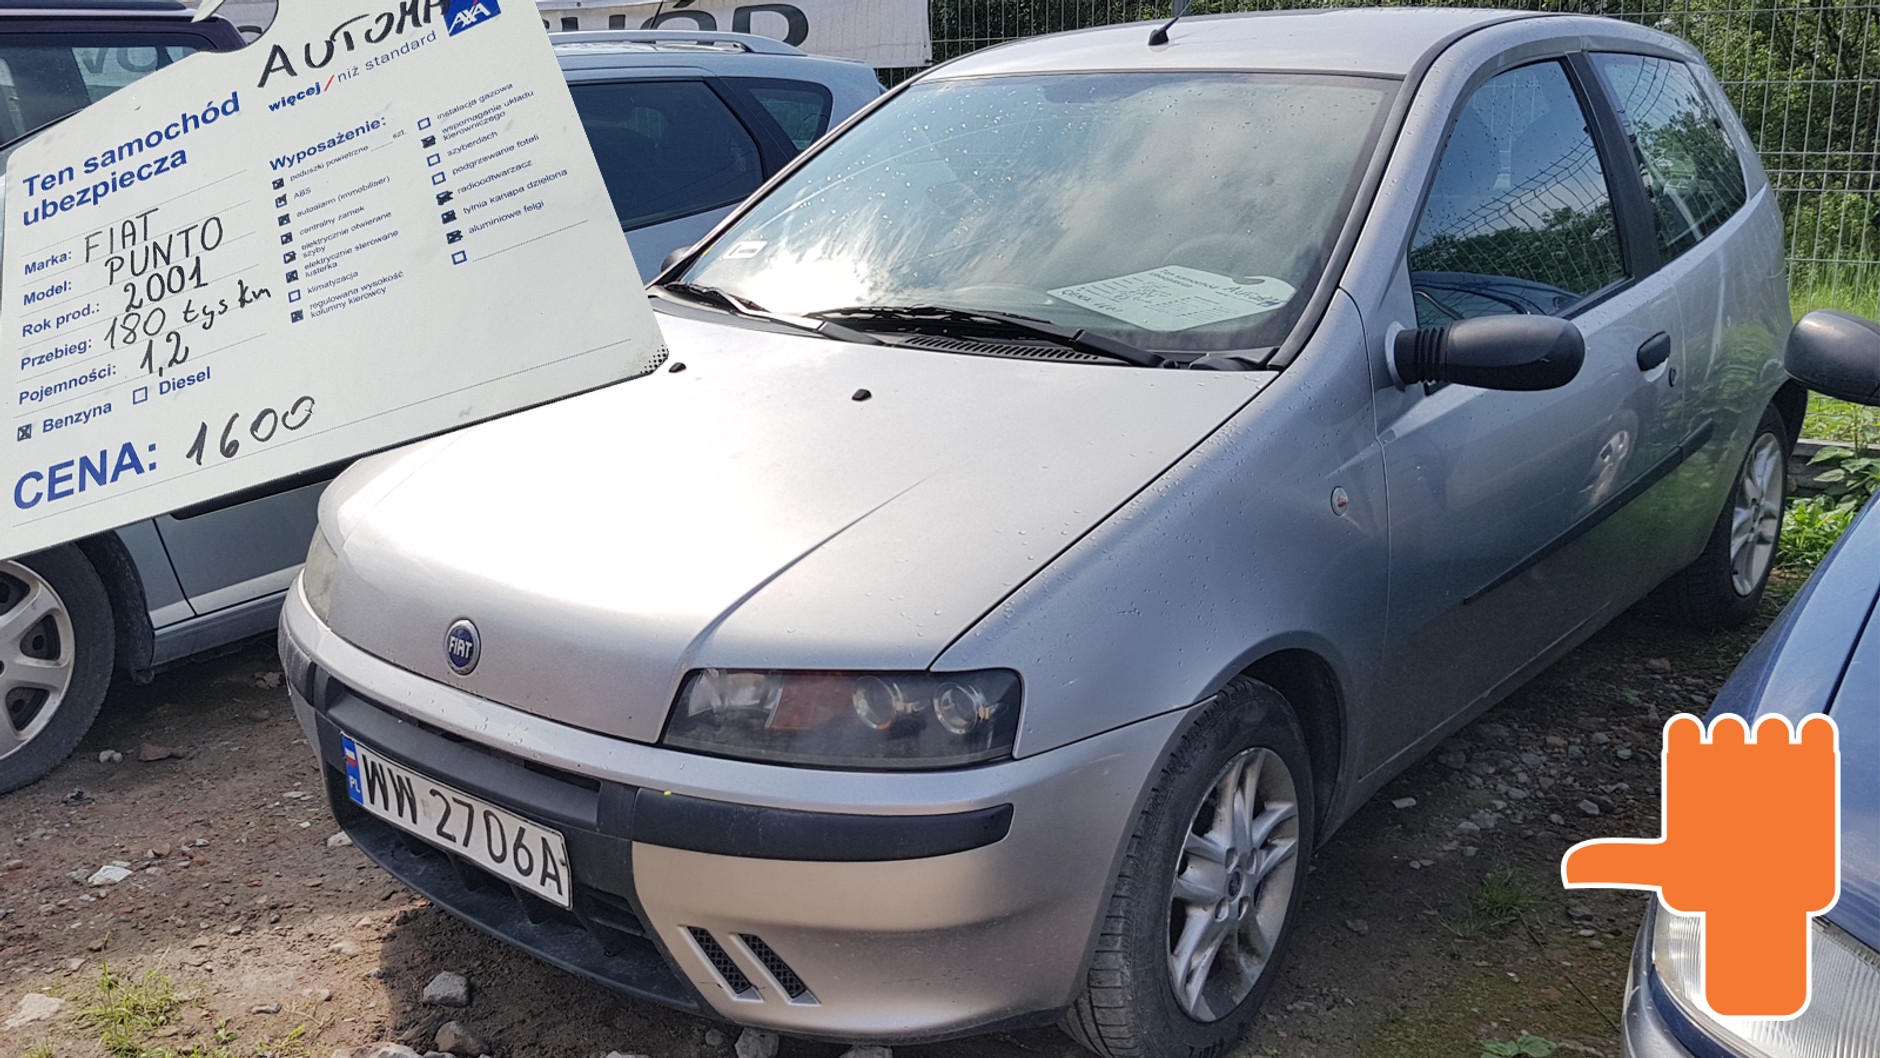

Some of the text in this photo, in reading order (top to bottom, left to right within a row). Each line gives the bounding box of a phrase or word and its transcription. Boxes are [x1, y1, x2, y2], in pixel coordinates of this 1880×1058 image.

[449, 3, 491, 33] AXA
[268, 83, 321, 112] więcej
[337, 64, 360, 84] niż
[365, 30, 437, 71] standard
[437, 82, 514, 121] instalacja gazowa
[441, 104, 502, 133] wspomaganie
[443, 111, 506, 141] kierowniczego
[23, 92, 241, 197] Ten samochód
[269, 117, 386, 171] Wyposażenie:
[325, 145, 369, 168] powietrzne
[447, 131, 499, 157] szyberdach
[452, 133, 540, 175] podgrzewanie foteli
[23, 149, 187, 226] ubezpiecza
[294, 187, 312, 199] ABS
[457, 160, 533, 194] radioodtwarzacz
[489, 187, 525, 206] kanapa
[527, 168, 568, 189] dzielona
[299, 205, 365, 235] centralny zamek
[301, 212, 392, 250] elektrycznie otwierane
[468, 200, 545, 234] aluminiowe felgi
[85, 208, 159, 263] FIAT
[105, 216, 223, 286] PUNTO
[302, 245, 326, 259] szyby
[304, 229, 399, 270] elektrycznie sterowane
[25, 250, 72, 275] Marka:
[305, 262, 338, 279] lusterka
[23, 281, 72, 305] Model:
[124, 256, 208, 313] 2001
[307, 271, 359, 294] klimatyzacja
[309, 270, 404, 310] regulowana wysokość
[22, 303, 100, 337] Rok prod.:
[104, 280, 271, 349] 180 tys km
[310, 287, 387, 319] kolumny kierowcy
[21, 339, 92, 370] Przebieg:
[140, 332, 188, 377] 1,2
[19, 364, 116, 405] Pojemności:
[159, 367, 211, 395] Diesel
[43, 403, 112, 433] Benzyna
[186, 396, 314, 466] 1600
[13, 440, 156, 509] CENA:
[448, 637, 473, 658] FIAT
[349, 775, 360, 793] PL
[362, 754, 563, 896] WW 2706A
